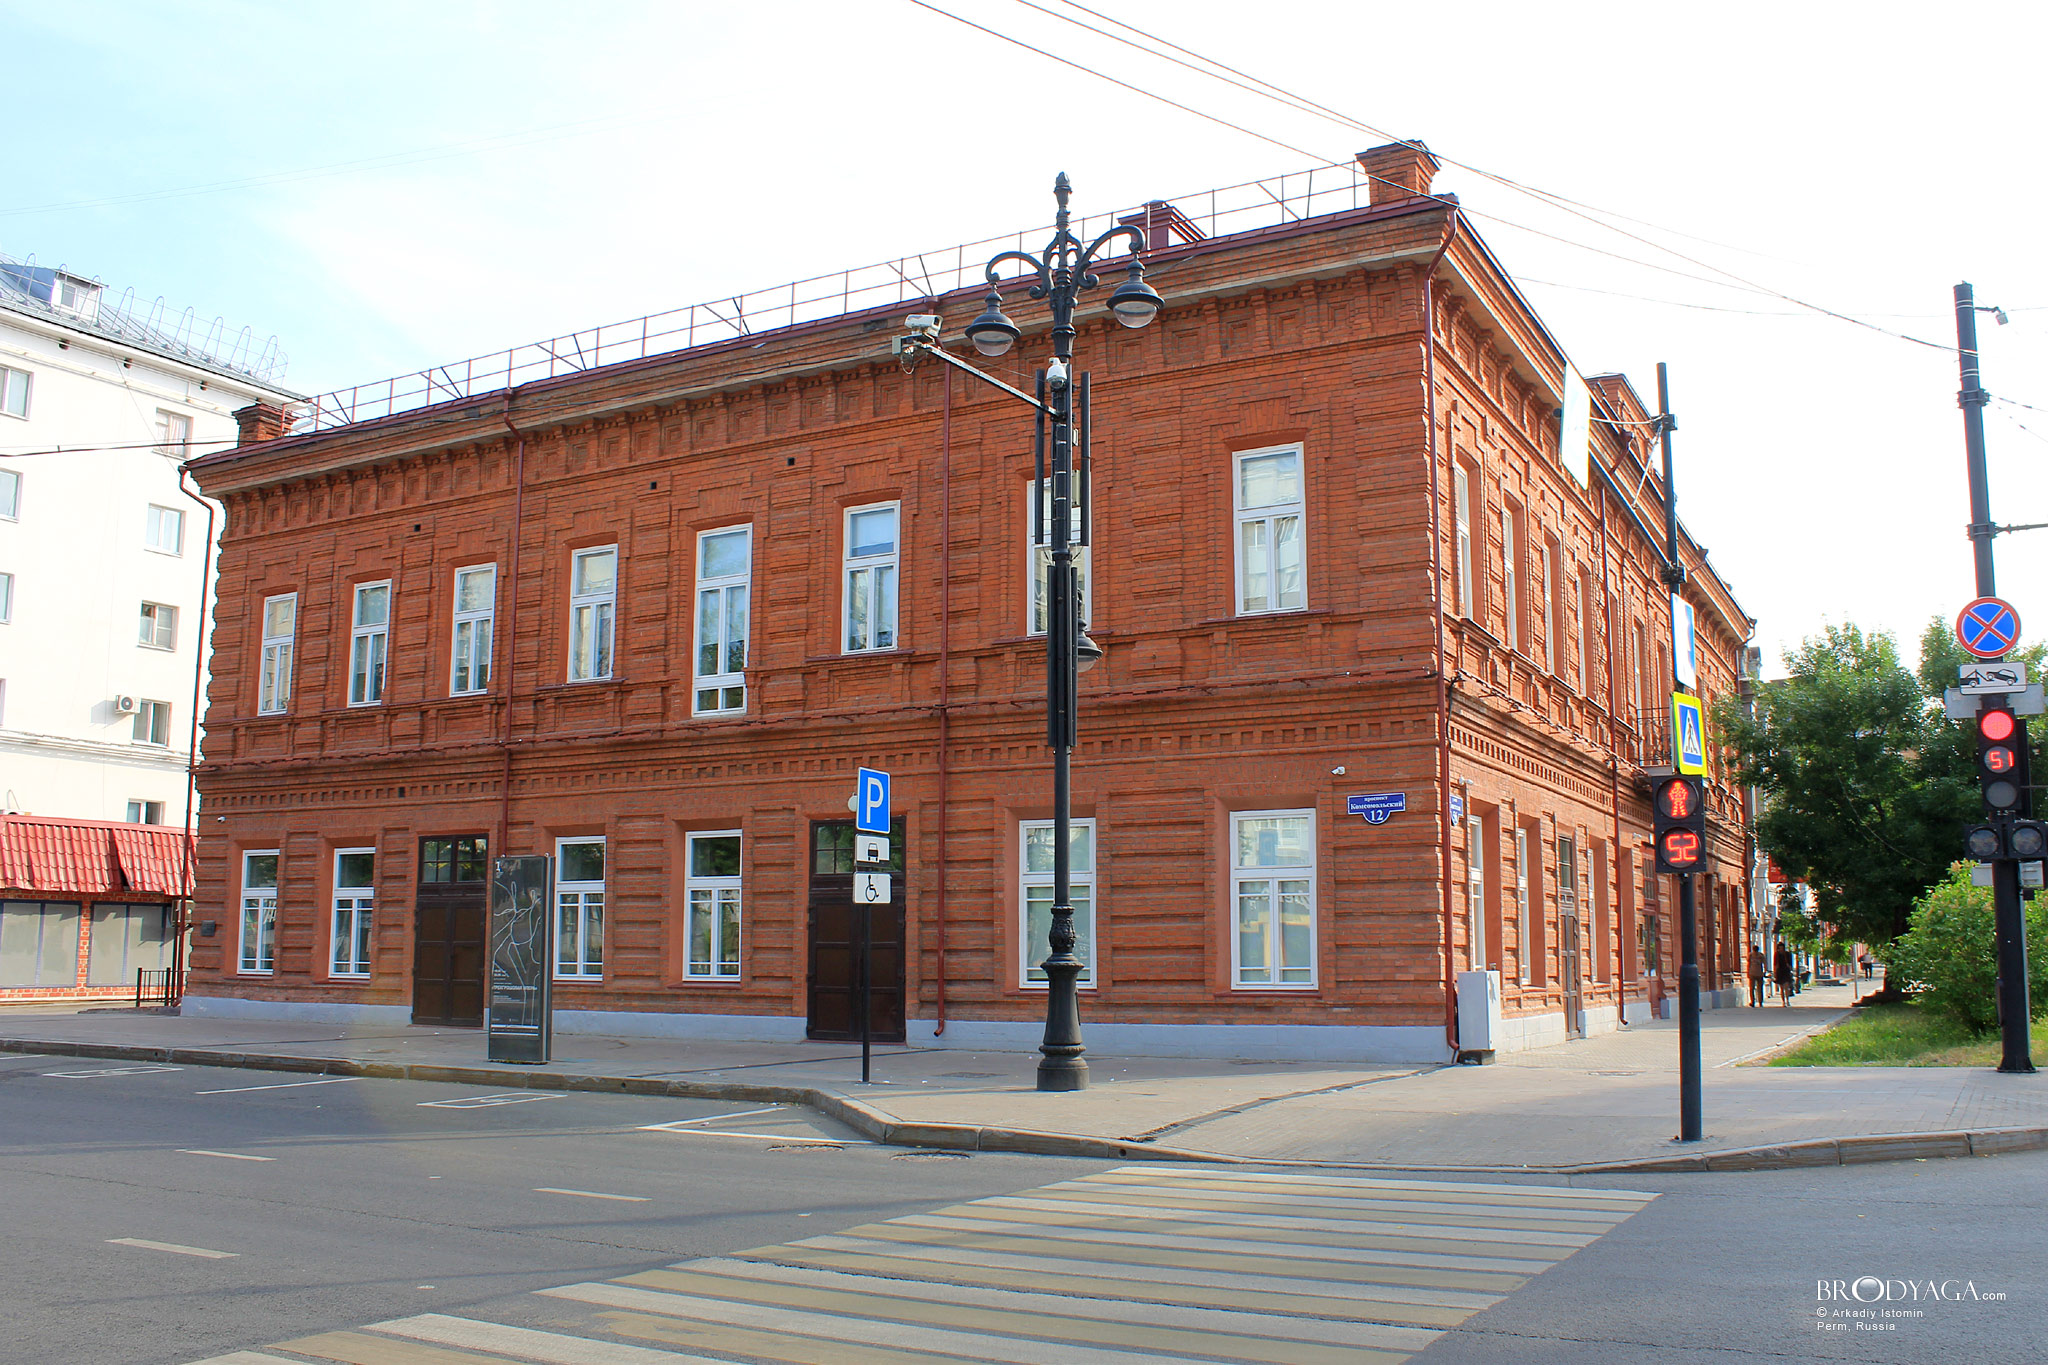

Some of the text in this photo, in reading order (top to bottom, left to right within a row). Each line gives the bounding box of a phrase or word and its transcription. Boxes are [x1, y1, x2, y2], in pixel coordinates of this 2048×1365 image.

[1989, 750, 2015, 770] 51
[866, 776, 884, 824] P
[1350, 800, 1403, 810] Комсомольский
[1370, 809, 1384, 821] 12
[1666, 833, 1698, 863] 52
